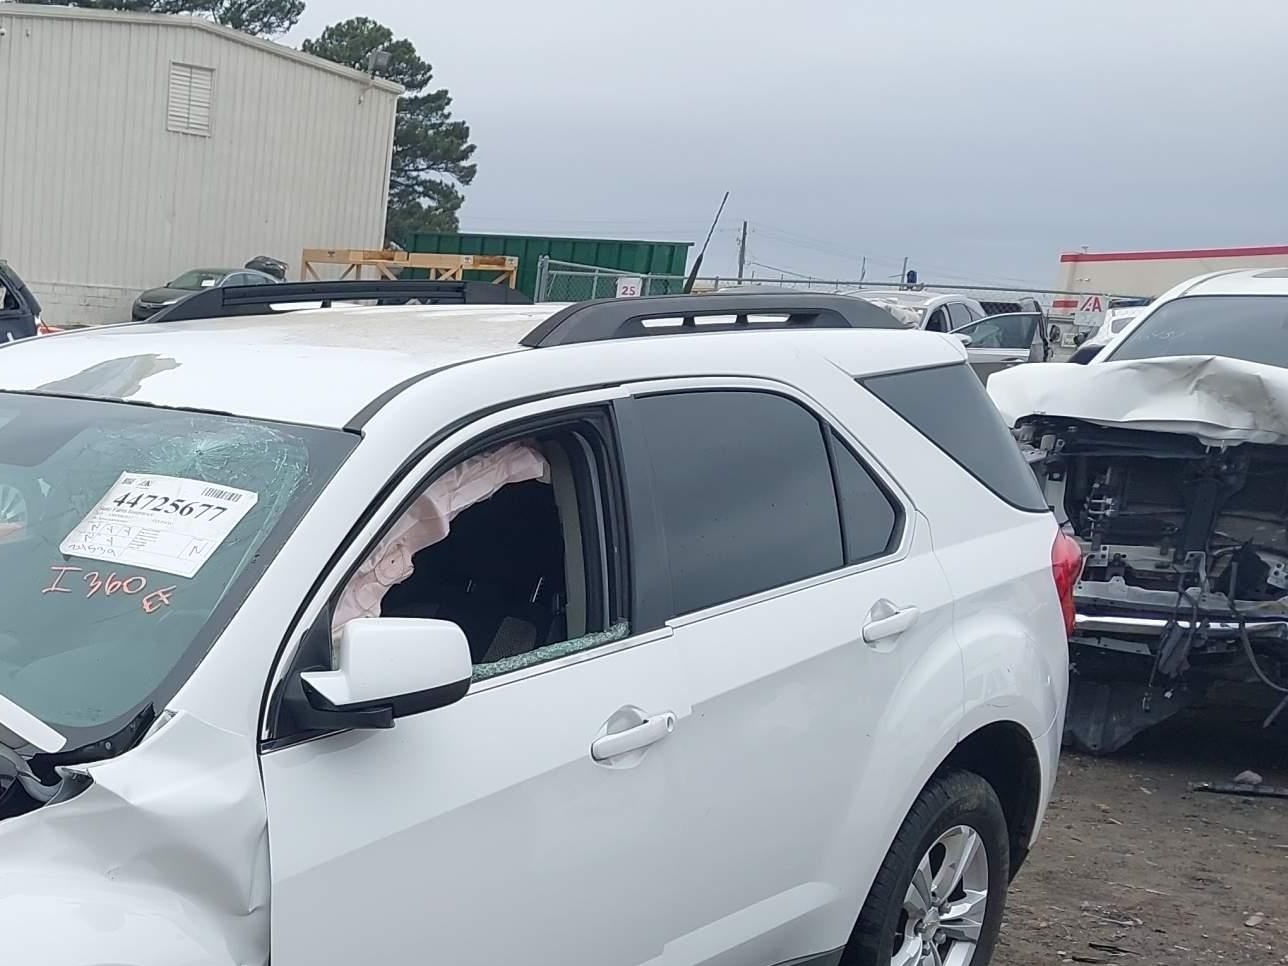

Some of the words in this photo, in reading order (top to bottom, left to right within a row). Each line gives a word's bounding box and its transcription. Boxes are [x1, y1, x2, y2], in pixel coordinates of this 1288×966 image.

[621, 285, 636, 296] 25
[113, 491, 228, 521] 44725677
[83, 571, 147, 599] 360
